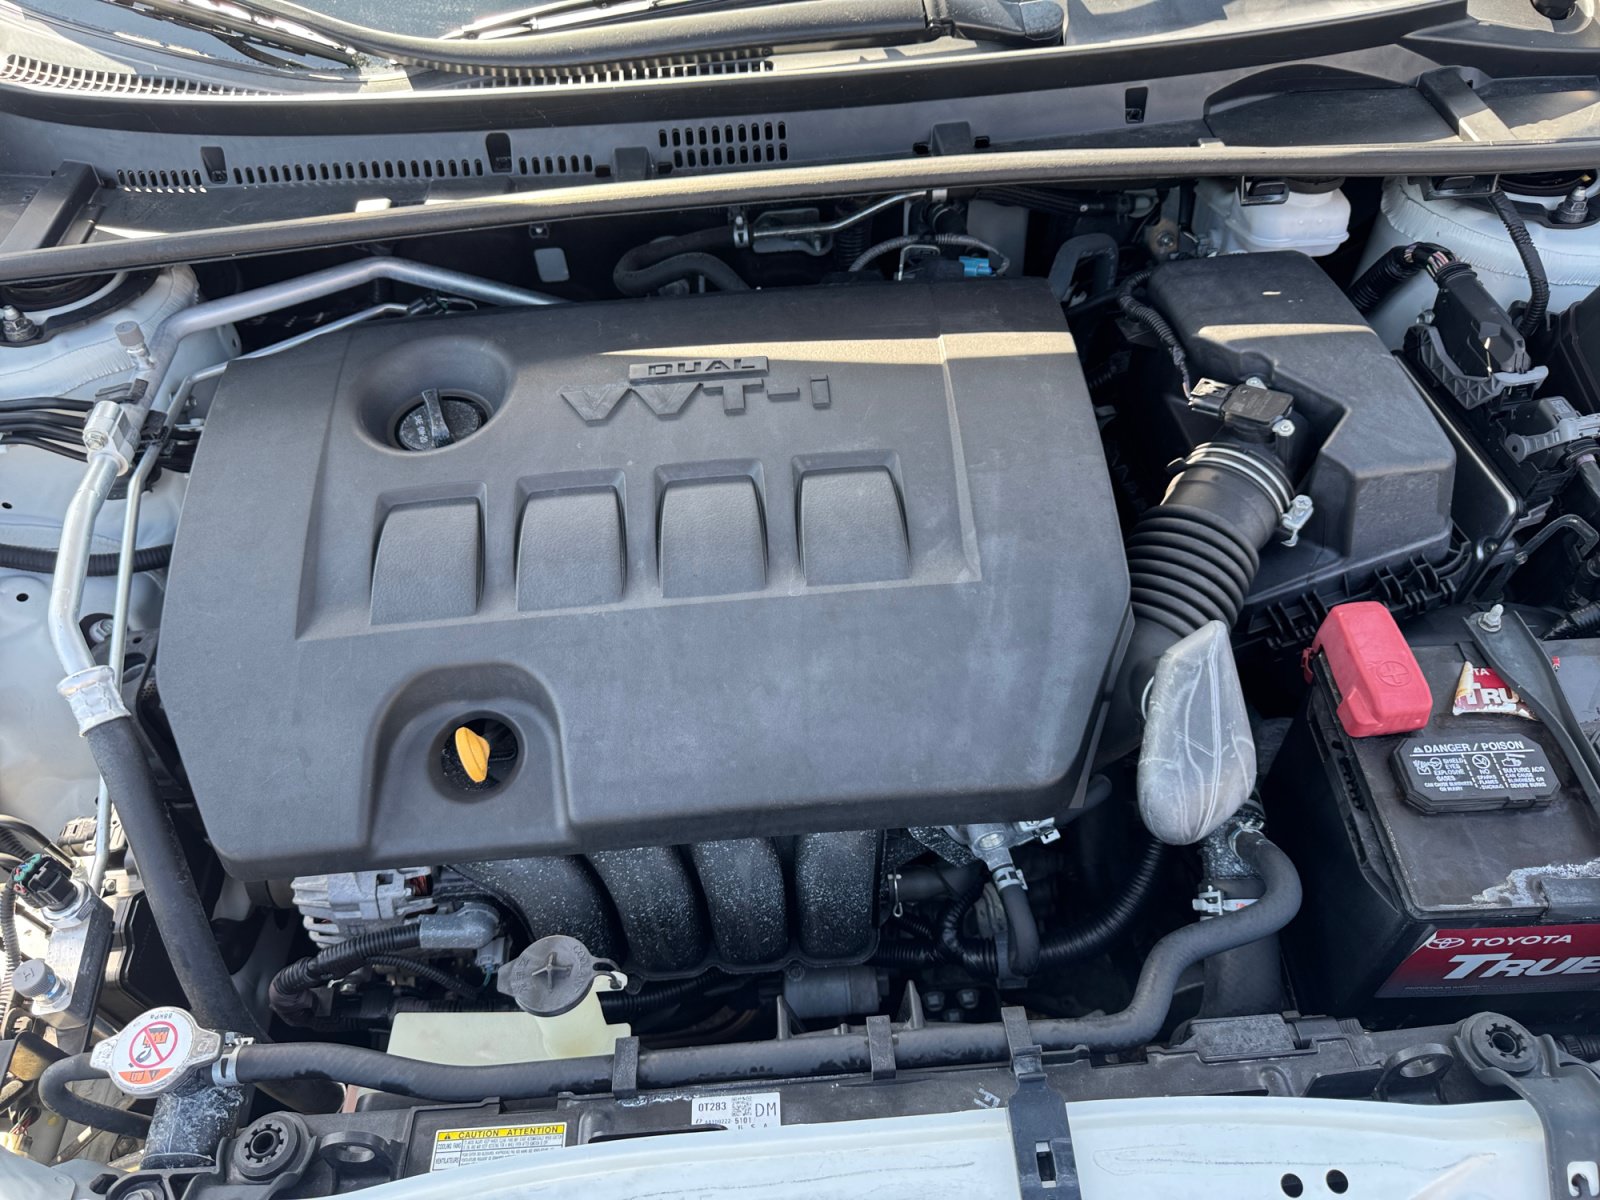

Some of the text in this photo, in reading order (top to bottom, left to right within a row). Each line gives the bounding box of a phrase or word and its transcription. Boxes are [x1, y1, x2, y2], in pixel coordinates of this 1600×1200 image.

[648, 358, 756, 375] DUAL
[1423, 743, 1471, 753] DANGER
[1481, 740, 1524, 751] POISON
[1433, 768, 1465, 776] EXPLOSIVE
[1471, 934, 1572, 947] TOYOTA
[755, 1102, 777, 1118] DM
[458, 1125, 558, 1140] CAUTION ATTENTION
